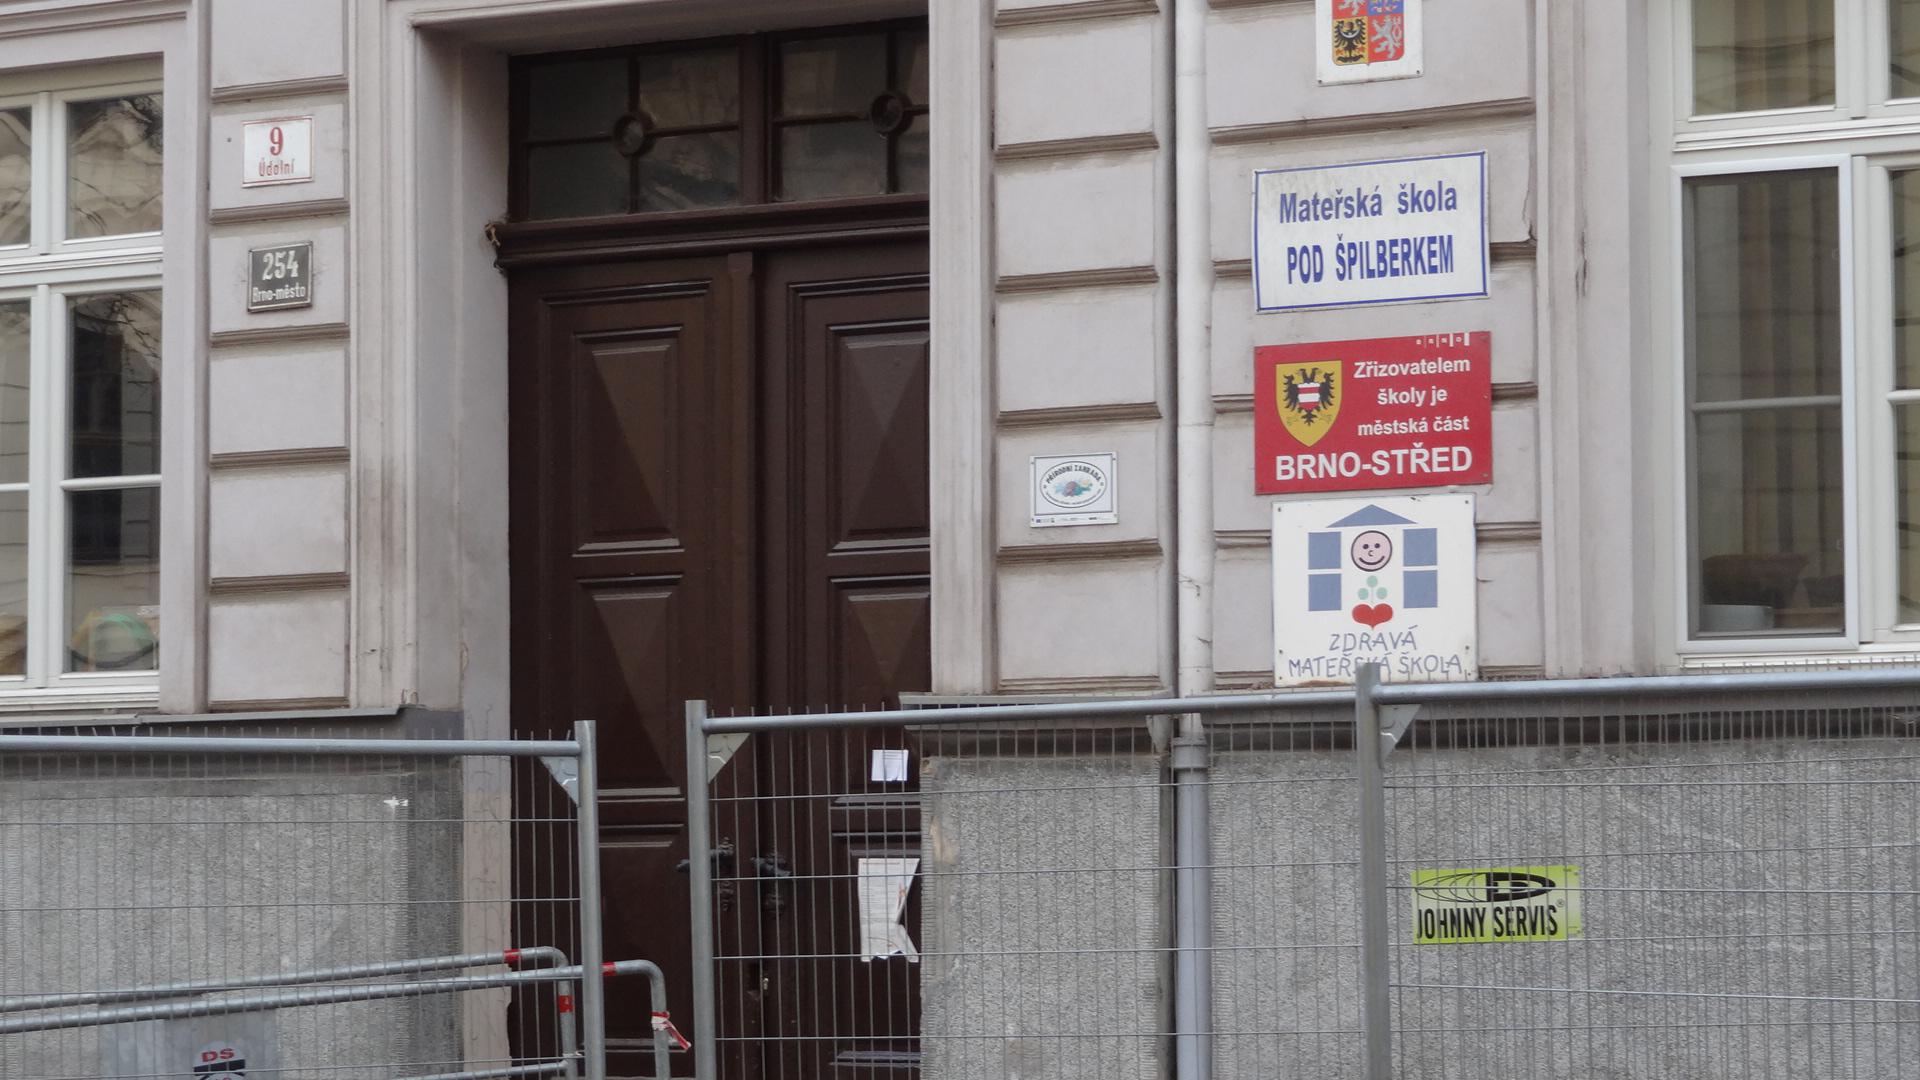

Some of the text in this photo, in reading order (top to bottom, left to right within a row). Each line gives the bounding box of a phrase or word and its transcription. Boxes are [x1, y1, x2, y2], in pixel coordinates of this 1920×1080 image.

[269, 127, 284, 156] 9
[258, 158, 295, 177] Údolní
[1279, 180, 1457, 224] Mateřská škola
[262, 250, 299, 281] 254
[1287, 233, 1454, 285] POD ŠPILBERKEM
[252, 282, 306, 303] Brno-město
[1353, 357, 1471, 379] Zřizovatelem
[1377, 386, 1448, 407] školy je
[1357, 415, 1470, 436] městská část
[1275, 442, 1473, 481] BRNO-STŘED
[1329, 624, 1419, 652] ZDRAVÁ
[1398, 651, 1462, 675] ŠKOLA
[1416, 904, 1558, 939] JOHNNY SERVIS
[201, 1048, 234, 1063] DS
